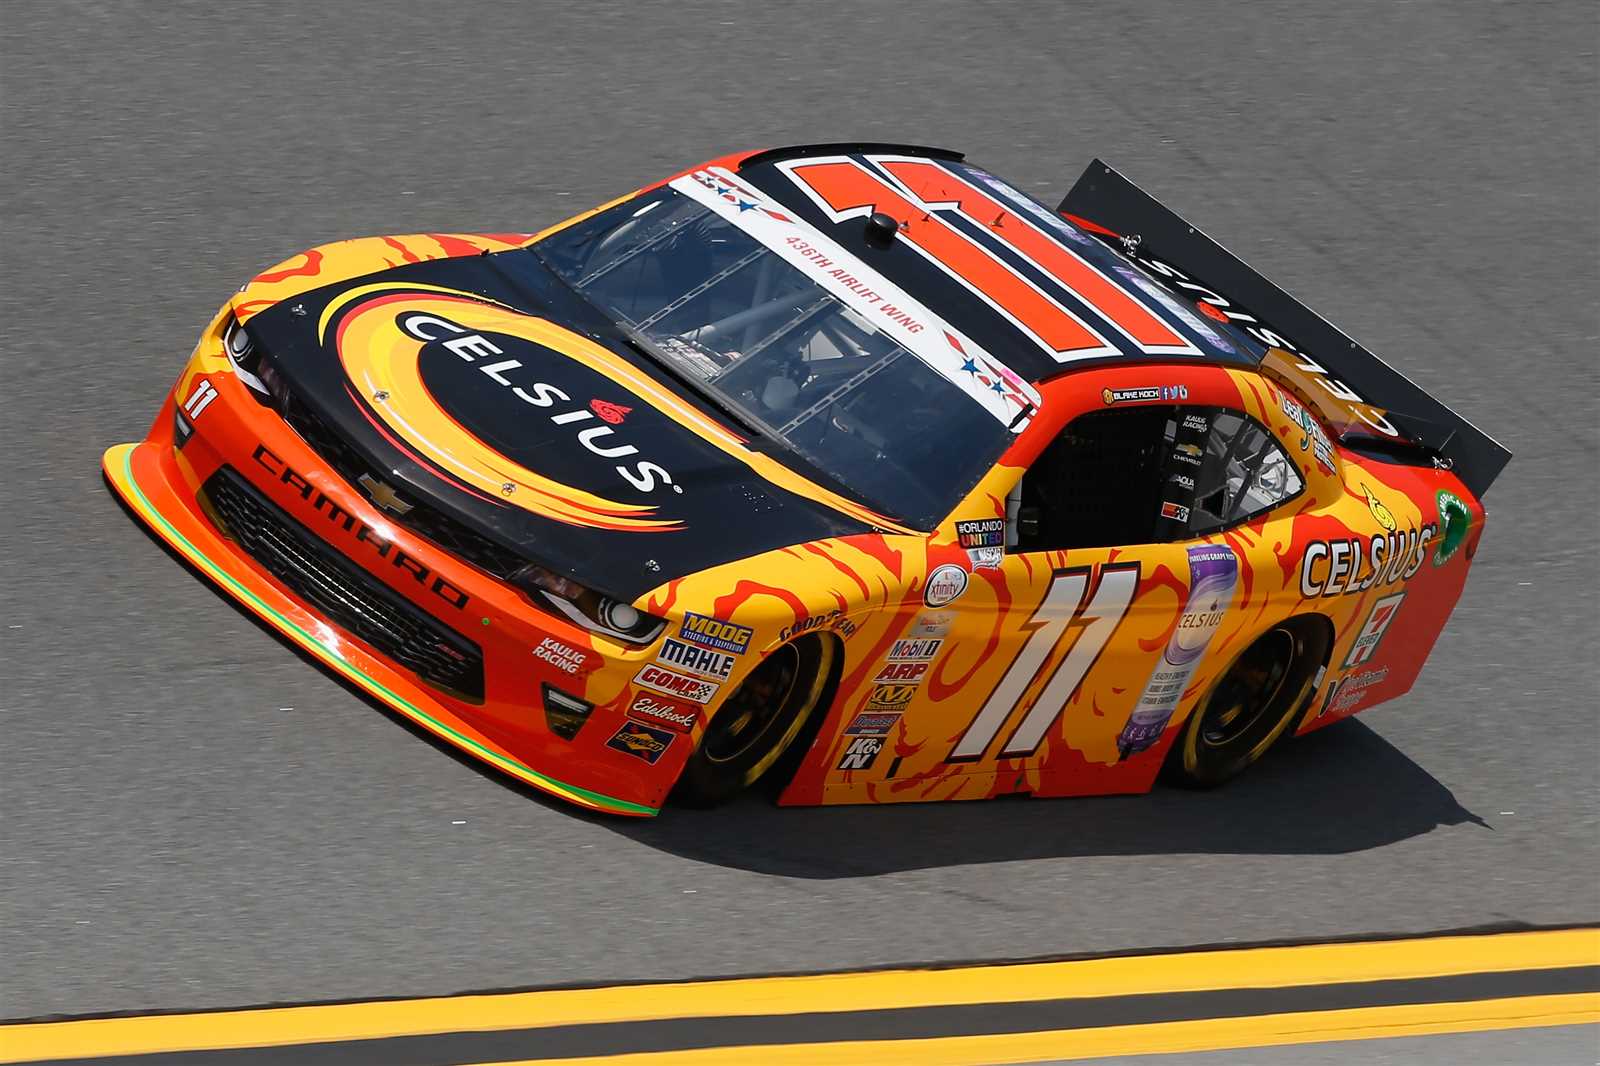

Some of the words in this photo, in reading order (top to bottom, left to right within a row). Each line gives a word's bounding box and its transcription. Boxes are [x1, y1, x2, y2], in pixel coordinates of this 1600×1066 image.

[774, 153, 1204, 363] 11
[785, 235, 833, 268] 436TH
[828, 268, 884, 304] AIRLIFT
[879, 303, 924, 334] WING
[184, 379, 219, 420] 11
[403, 313, 673, 493] CELSIUS
[1113, 390, 1138, 400] BLAKE
[1138, 389, 1159, 399] KOCH
[252, 443, 471, 611] CAMARO
[958, 519, 1003, 534] #ORLANDO
[960, 532, 1002, 547] UNITED
[1299, 526, 1433, 599] CELSIUS
[684, 615, 752, 646] MOOG
[1178, 611, 1224, 629] CELSIUS
[532, 645, 580, 673] RACING
[540, 636, 587, 664] KAULIG
[659, 639, 735, 677] MAHLE
[889, 640, 928, 657] Mobil
[926, 640, 941, 656] 1
[944, 560, 1142, 764] 11
[640, 667, 701, 694] COMP
[875, 663, 929, 680] ARP
[632, 697, 697, 727] Edelbrock
[617, 732, 666, 752] SUNOCO
